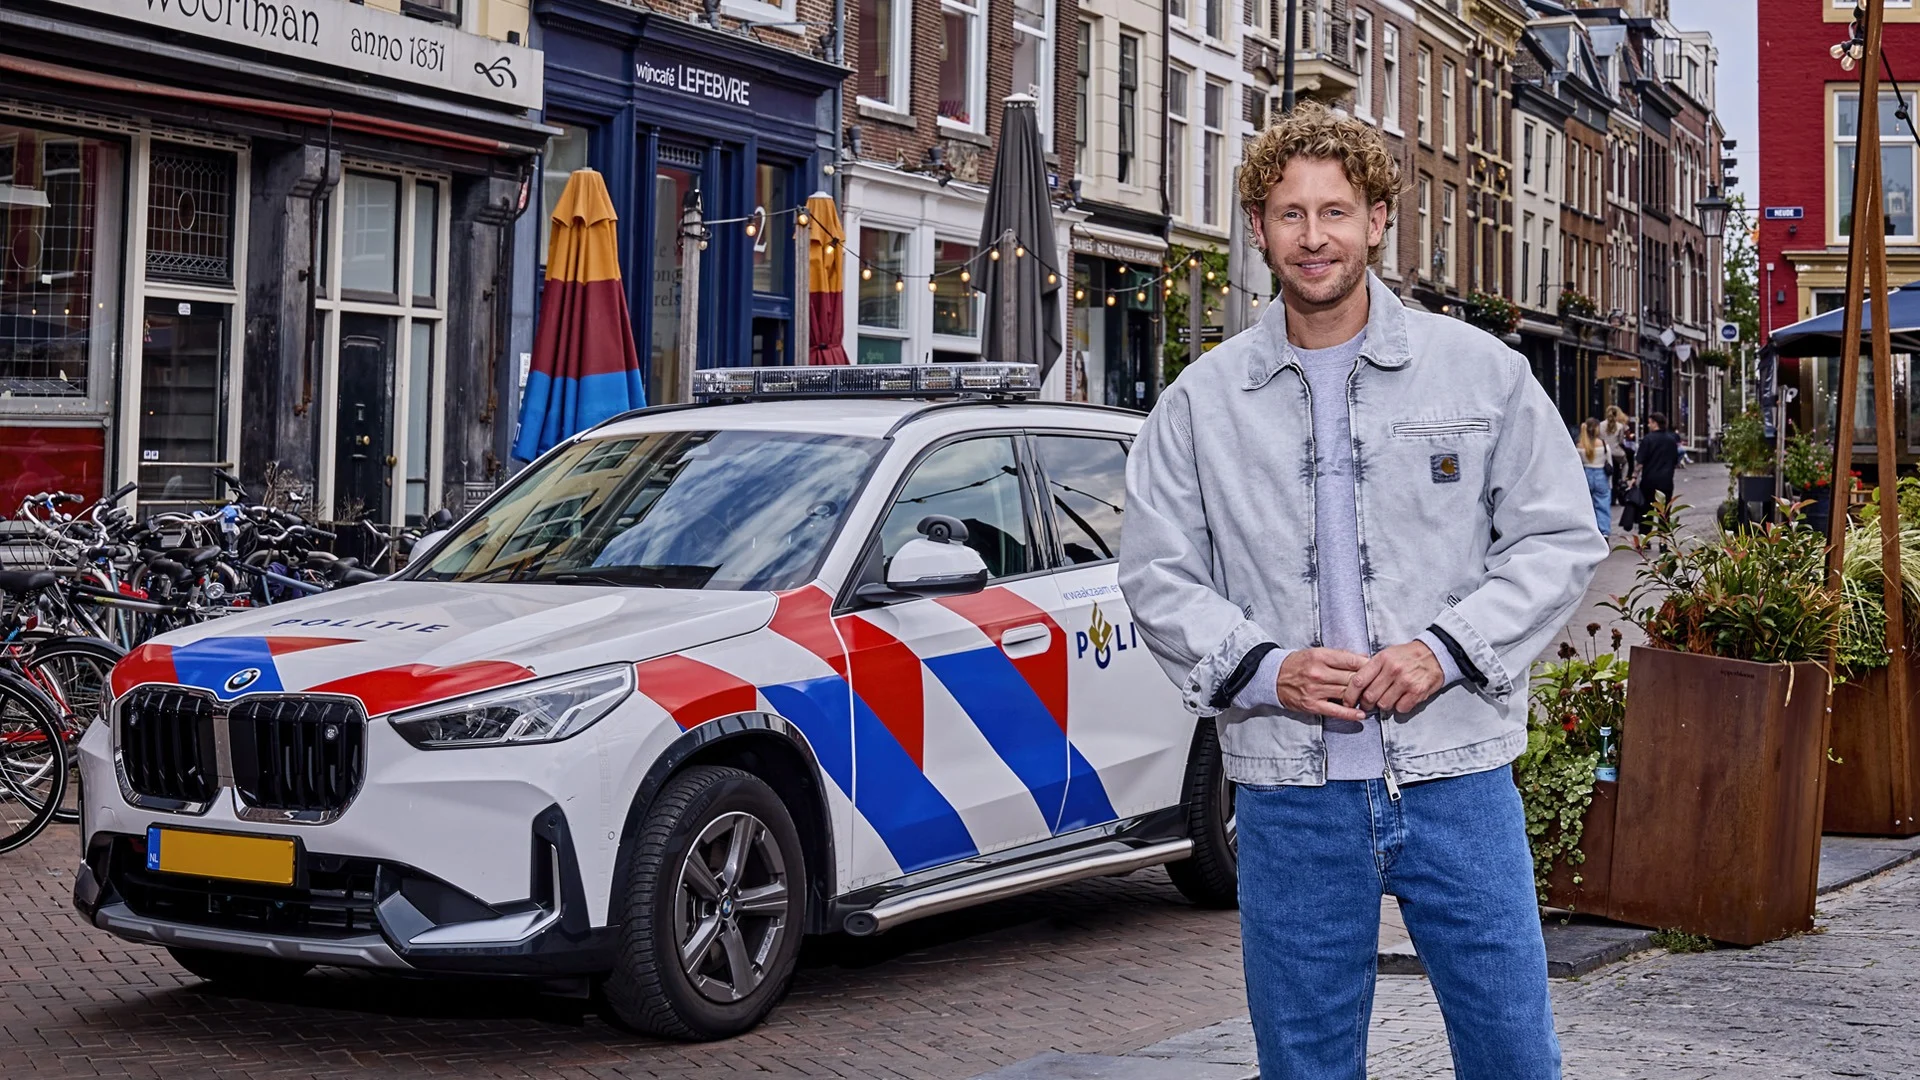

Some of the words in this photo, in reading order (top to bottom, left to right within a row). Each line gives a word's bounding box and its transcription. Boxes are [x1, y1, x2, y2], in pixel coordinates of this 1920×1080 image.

[145, 0, 320, 46] oortman
[350, 28, 402, 61] anno
[408, 36, 446, 72] 1851
[635, 61, 676, 87] wijncafé
[677, 64, 751, 106] LEFEBVRE
[753, 205, 768, 253] 2
[271, 618, 450, 634] POLITIE
[149, 852, 159, 863] NL
